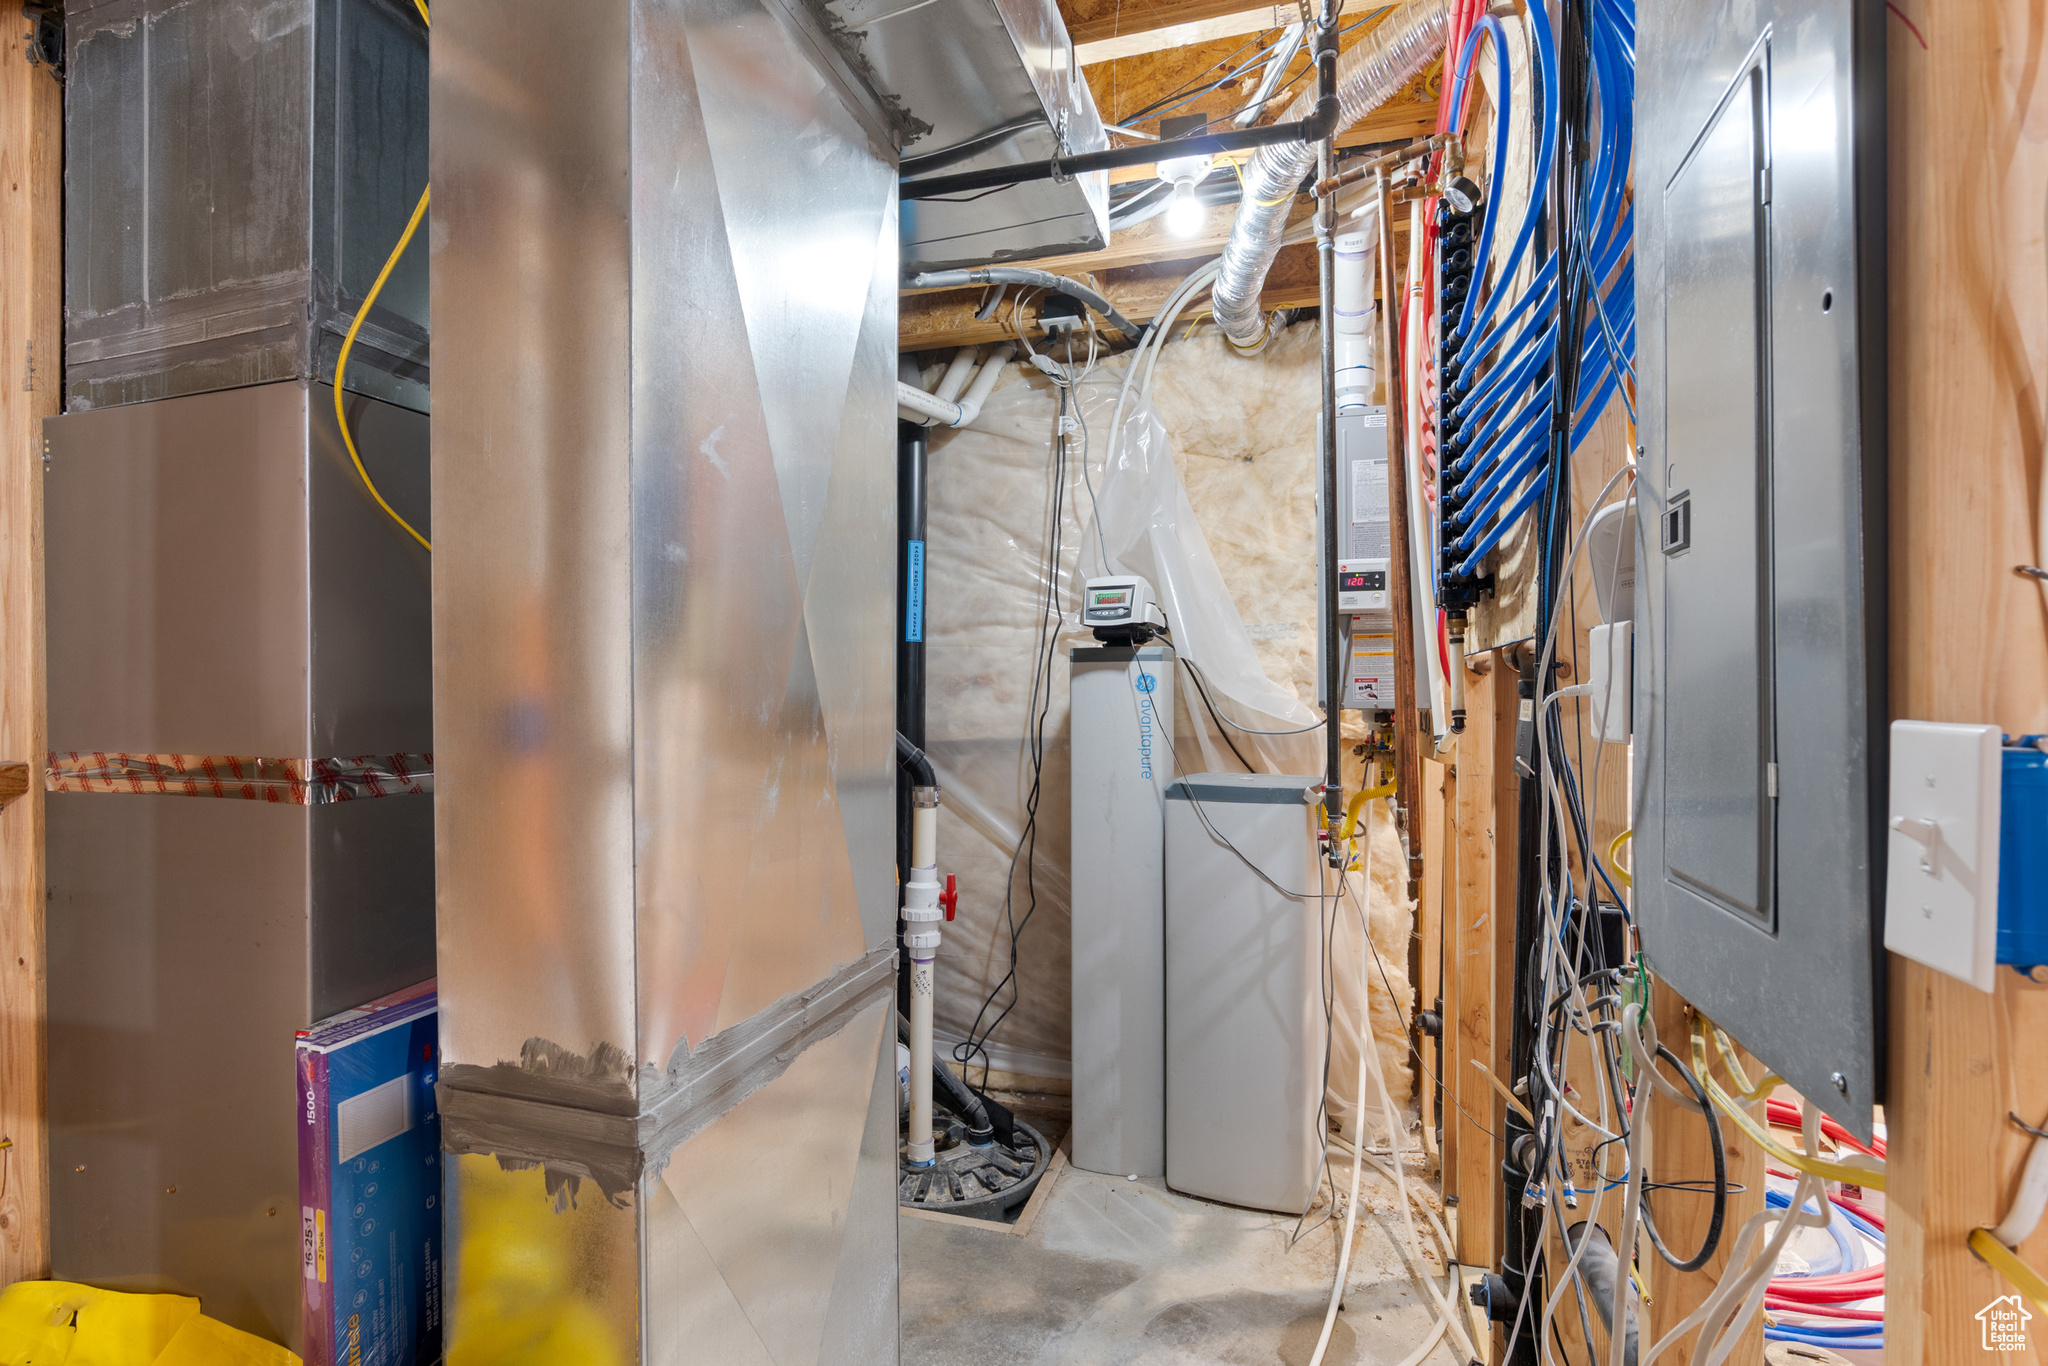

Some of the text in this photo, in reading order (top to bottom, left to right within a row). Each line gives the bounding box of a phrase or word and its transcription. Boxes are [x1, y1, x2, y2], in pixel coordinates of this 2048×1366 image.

[1346, 577, 1364, 586] 120
[1138, 699, 1153, 779] avantapure
[306, 1091, 316, 1126] 1500
